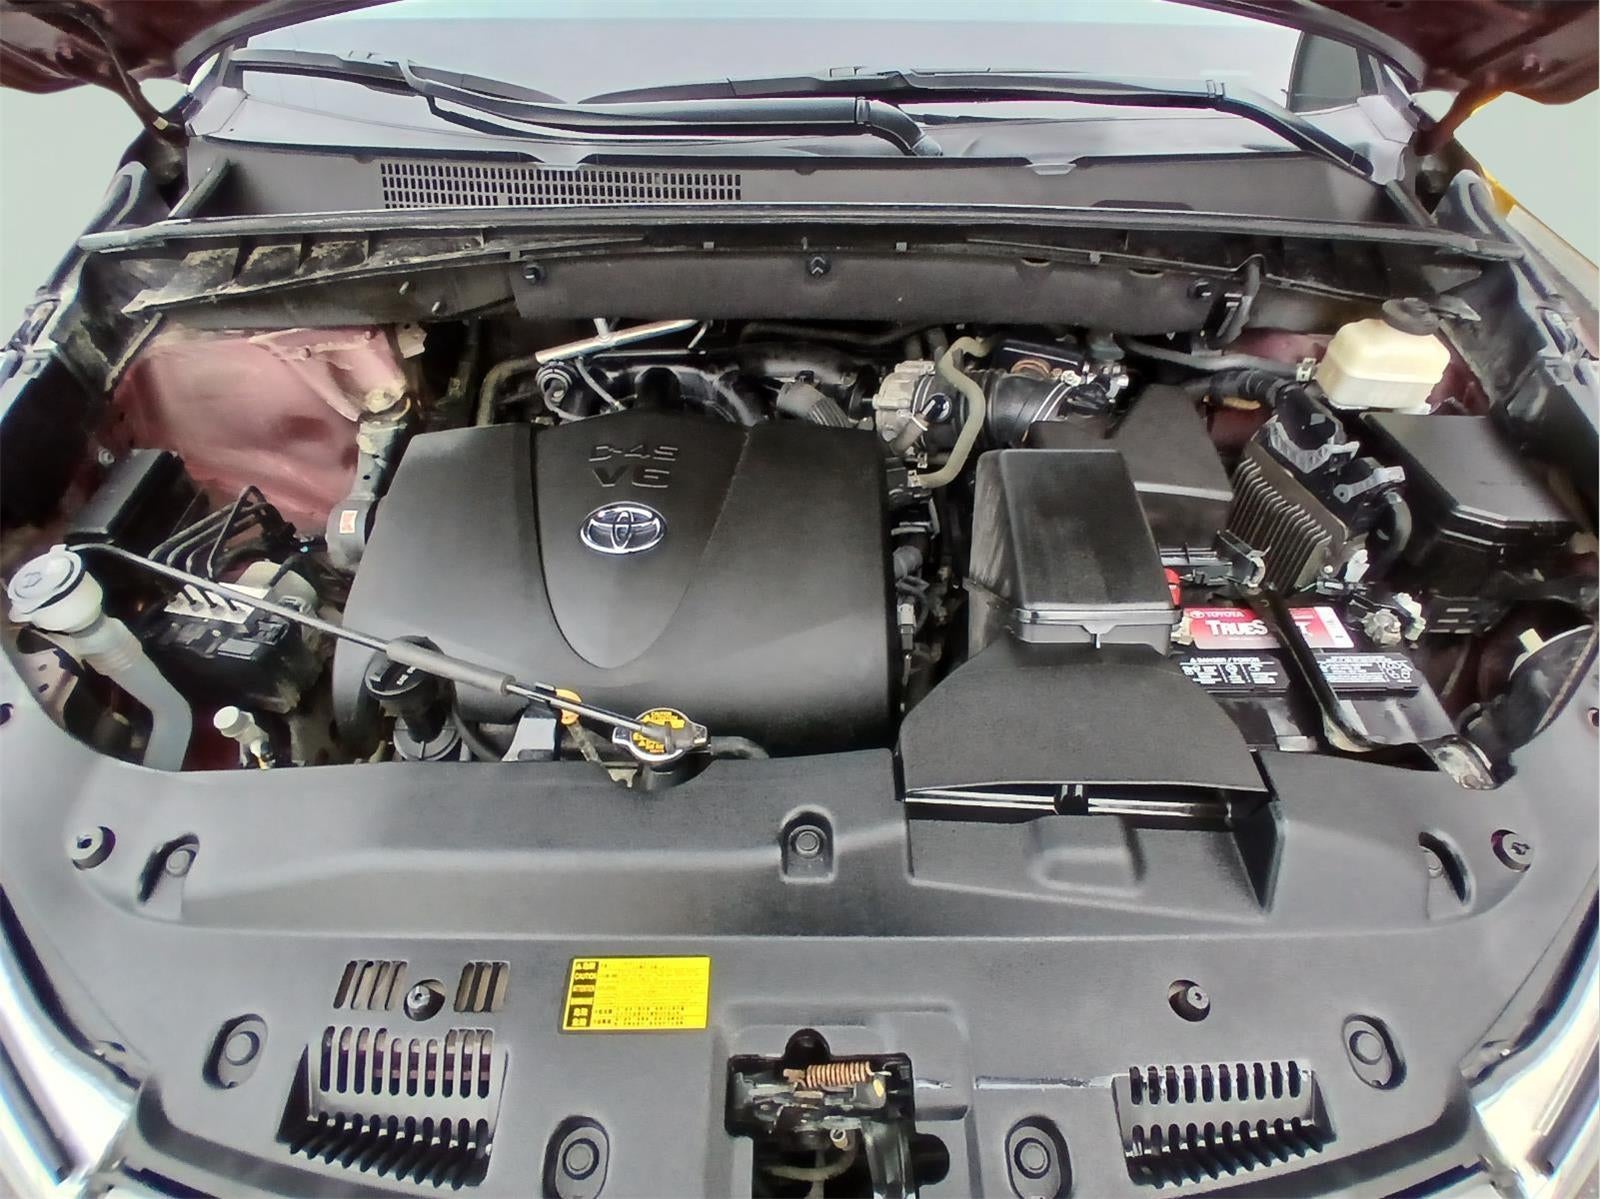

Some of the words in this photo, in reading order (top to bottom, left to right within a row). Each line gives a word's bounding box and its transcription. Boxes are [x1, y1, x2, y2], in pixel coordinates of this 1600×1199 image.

[588, 444, 679, 461] D-4S
[591, 465, 671, 488] V6
[1204, 610, 1245, 618] TOYOTA
